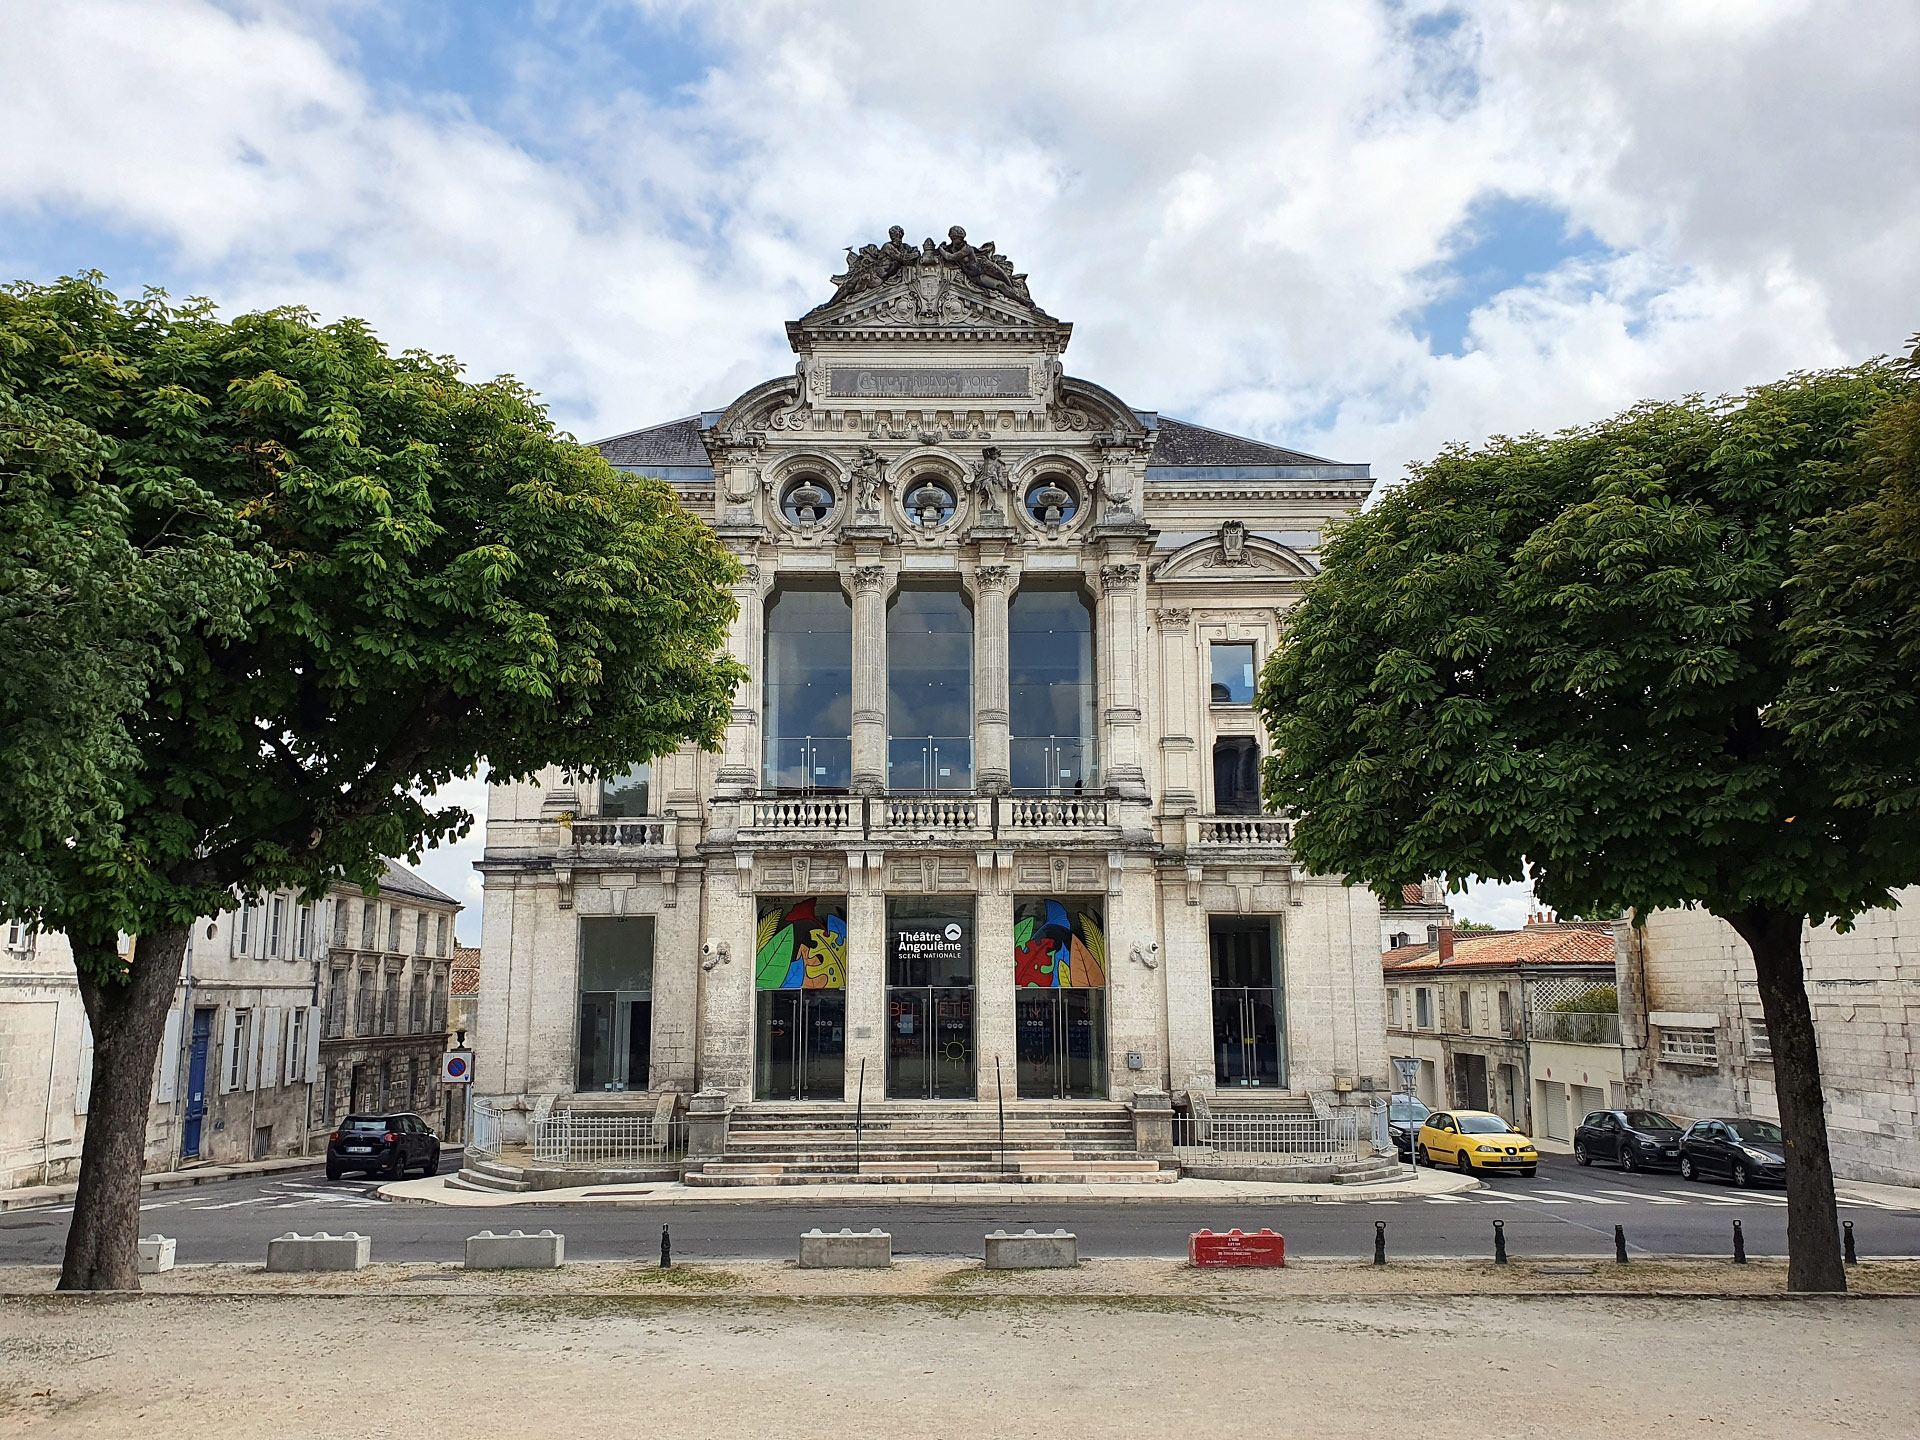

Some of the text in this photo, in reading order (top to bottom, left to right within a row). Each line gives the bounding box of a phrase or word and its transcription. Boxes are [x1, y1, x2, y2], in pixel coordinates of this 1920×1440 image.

[858, 372, 908, 389] CASTIGAT
[913, 375, 958, 387] RIDENDO
[898, 932, 941, 942] Théâtre
[898, 941, 962, 953] Angoulême
